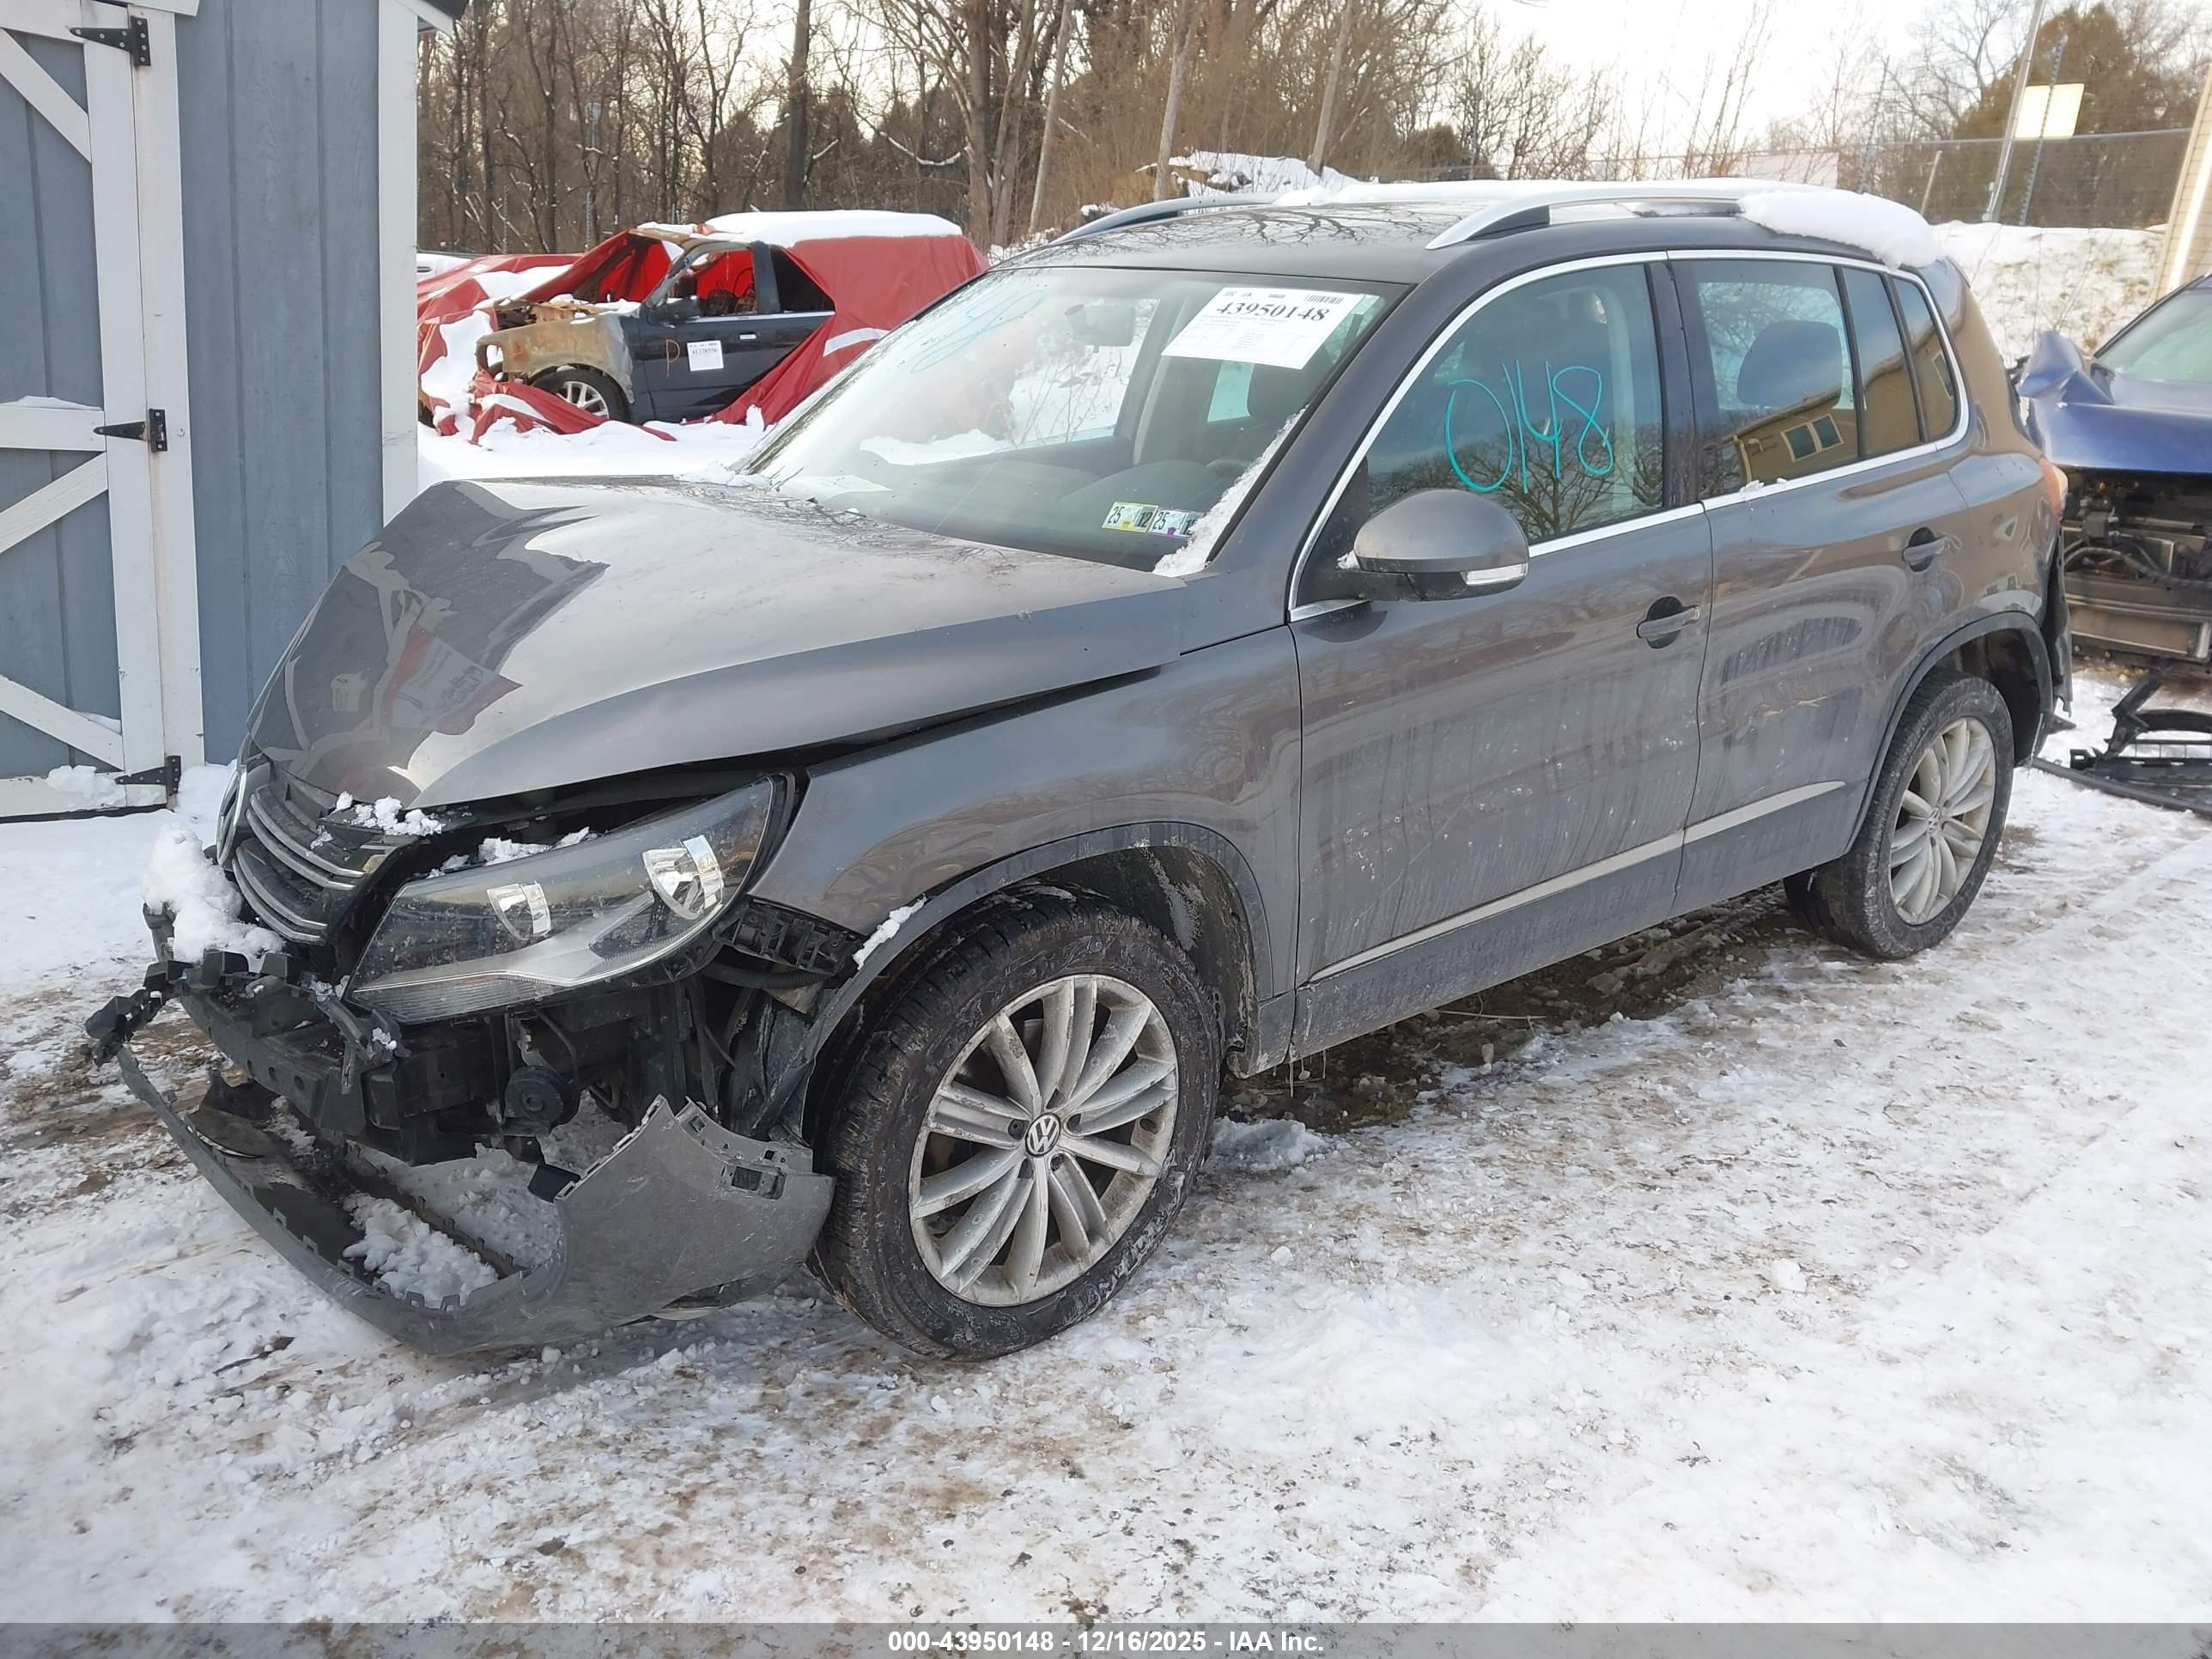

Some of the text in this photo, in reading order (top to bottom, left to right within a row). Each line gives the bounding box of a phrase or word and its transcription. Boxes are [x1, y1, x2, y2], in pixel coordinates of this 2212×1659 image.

[1216, 301, 1330, 321] 43950148
[1445, 358, 1614, 495] 0148
[1107, 506, 1153, 528] 25 12
[1152, 511, 1170, 530] 25
